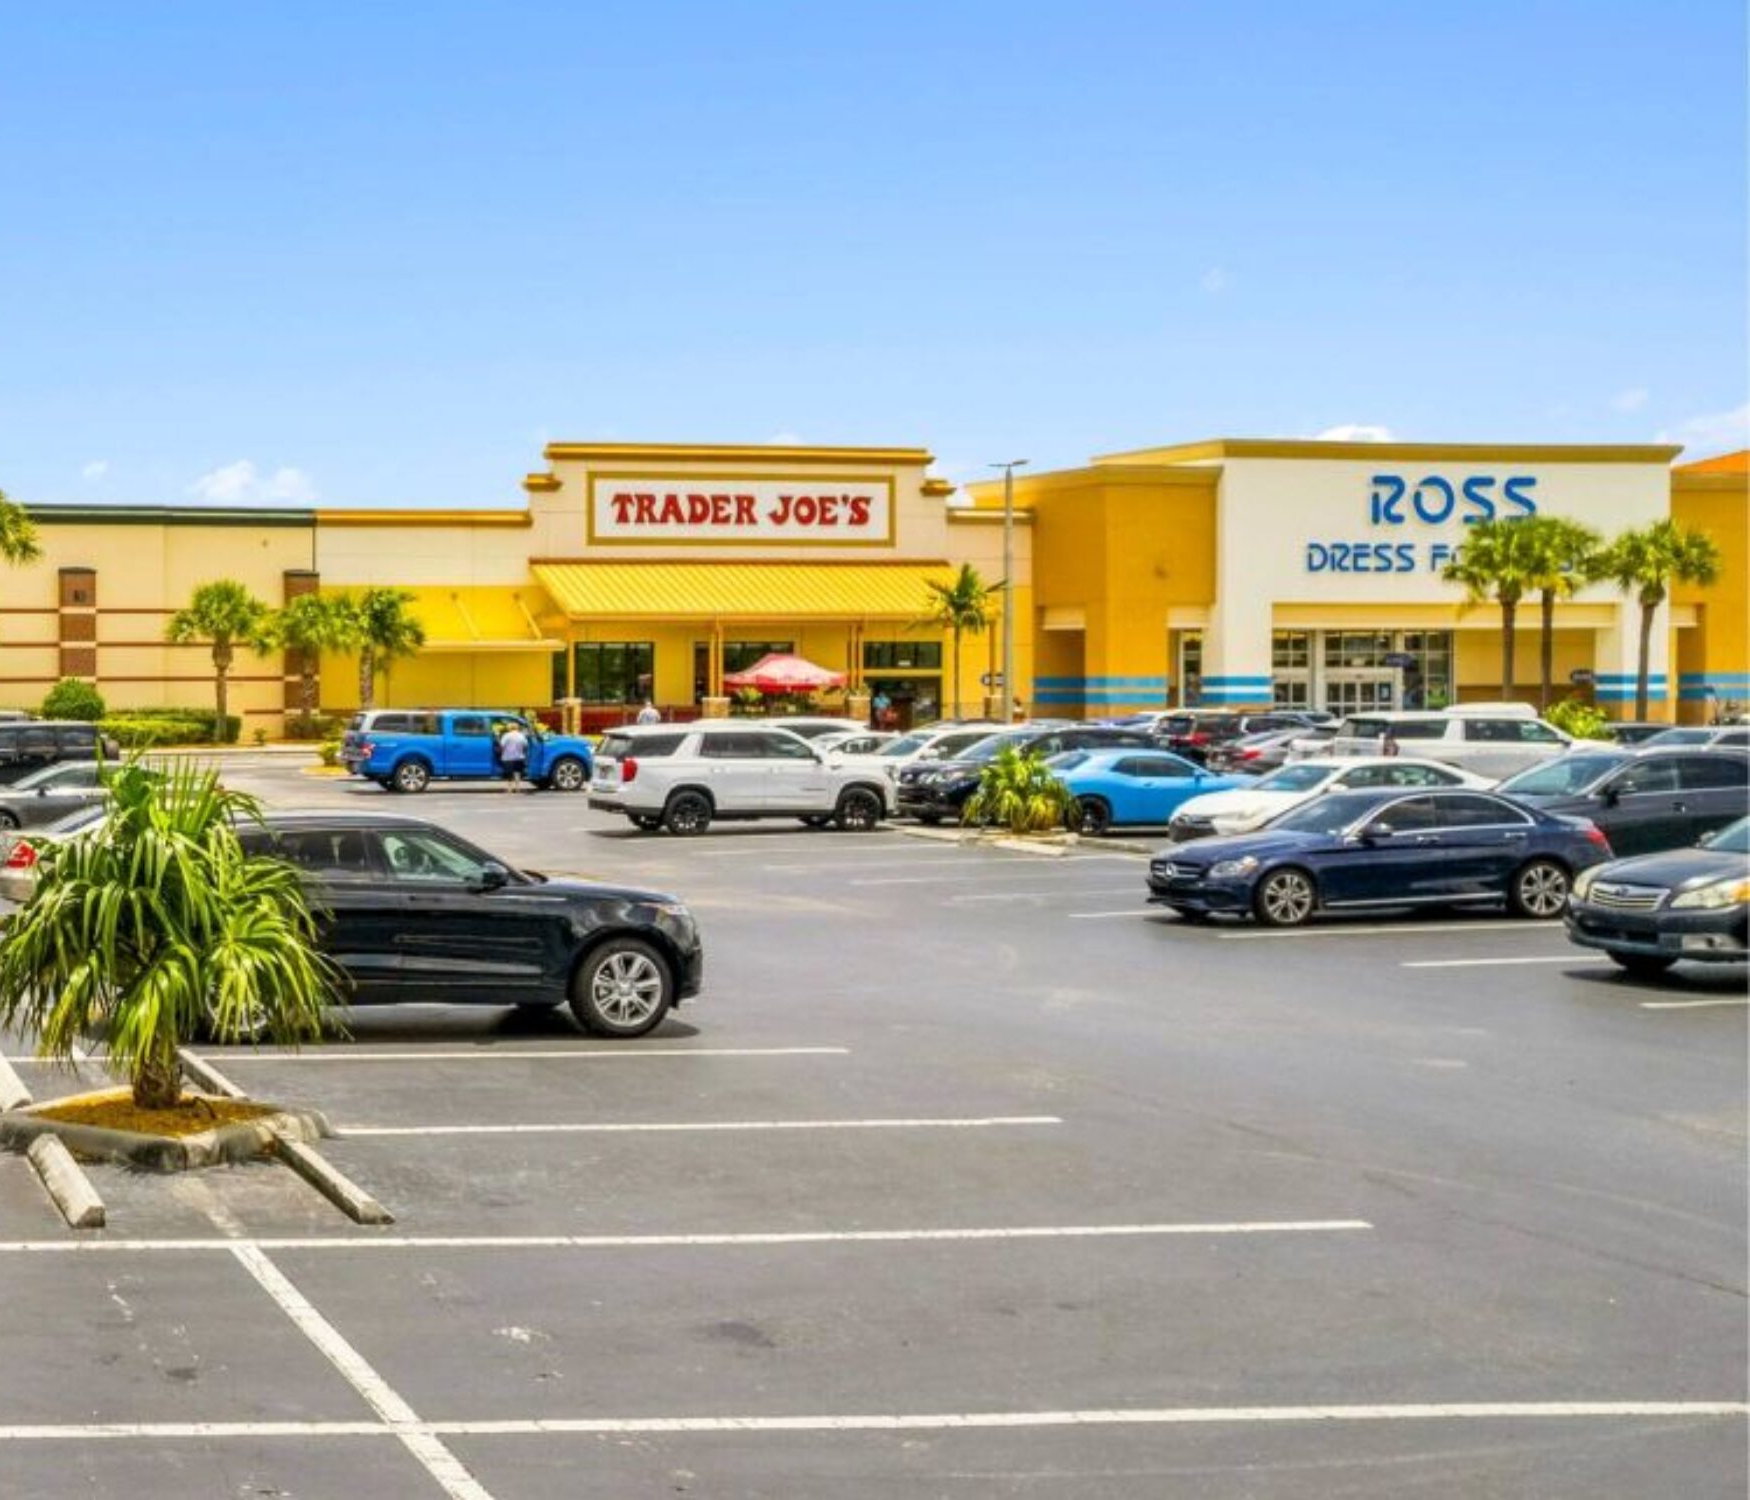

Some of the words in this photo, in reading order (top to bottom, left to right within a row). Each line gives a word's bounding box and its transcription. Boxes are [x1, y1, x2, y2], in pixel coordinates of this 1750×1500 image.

[611, 493, 758, 525] TRADER
[768, 495, 874, 526] JOE'S
[1370, 475, 1537, 525] ROSS
[1307, 543, 1415, 572] DRESS
